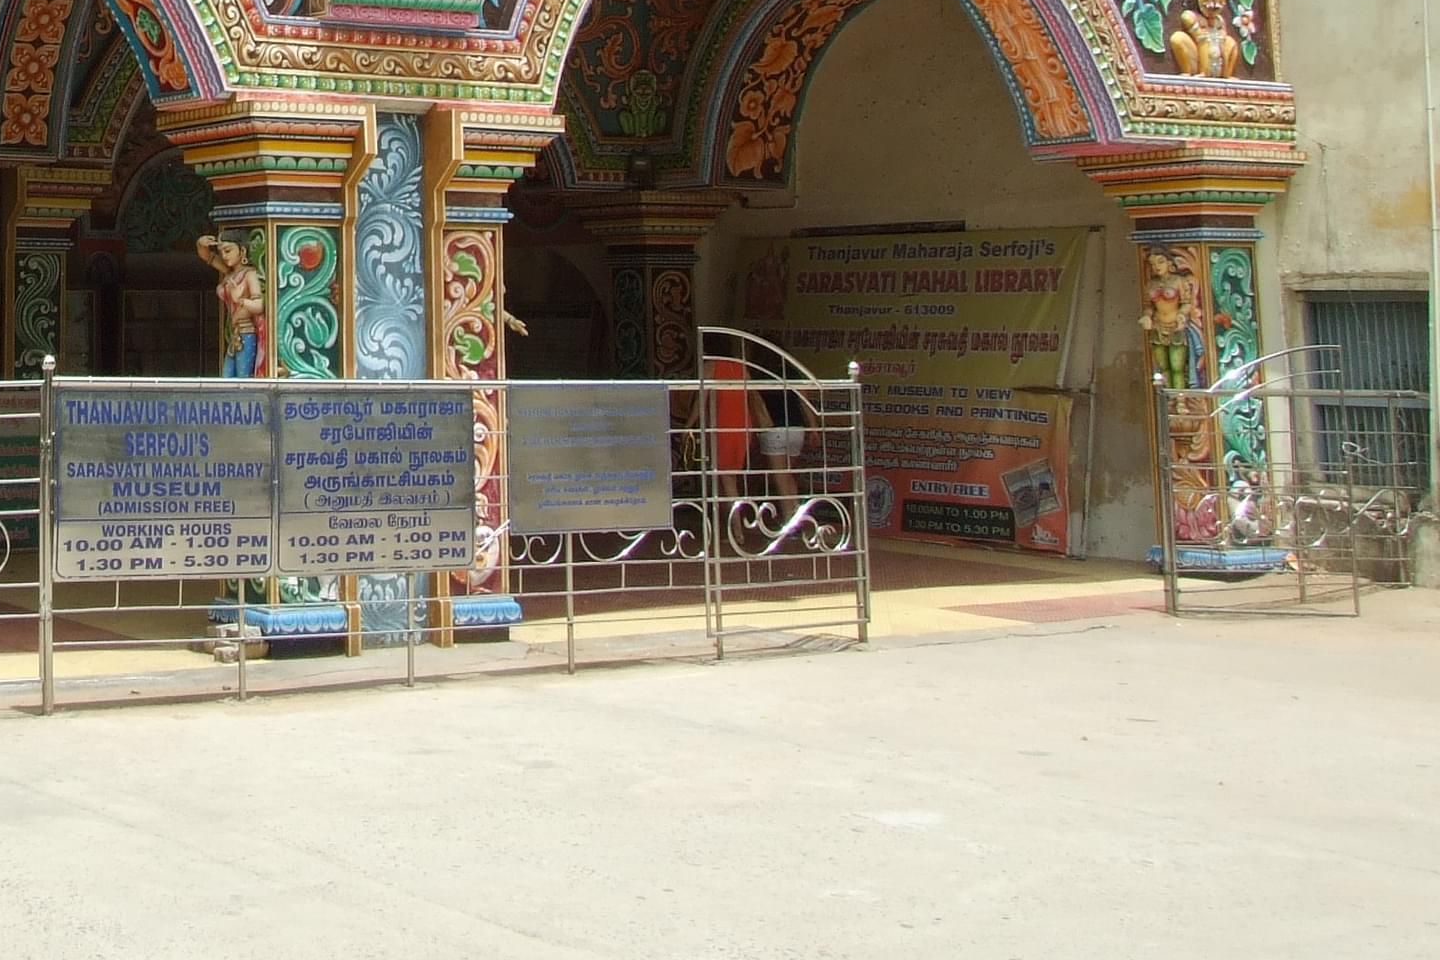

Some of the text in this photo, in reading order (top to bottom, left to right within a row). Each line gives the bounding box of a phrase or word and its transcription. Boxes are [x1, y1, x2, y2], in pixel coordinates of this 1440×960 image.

[808, 240, 1055, 264] Thanjavur Maharaja Serfoji's
[796, 268, 1062, 294] SARASVATI MAHAL LIBRARY
[828, 304, 893, 317] Thanjavur
[904, 304, 955, 315] 613009
[887, 385, 944, 398] MUSEUM
[951, 387, 968, 399] TO
[976, 389, 1011, 400] VIEW
[65, 400, 168, 425] THANJAVUR
[174, 401, 264, 425] MAHARAJA
[284, 397, 465, 421] தஞ்சாவூர் மகாராஜா
[936, 405, 964, 417] AND
[970, 406, 1049, 424] PAINTINGS
[319, 422, 433, 444] சரபோஜியின்
[124, 432, 210, 457] SERFOJI'S
[284, 446, 467, 471] சரசுவதி மகால் நூலகம்
[67, 462, 263, 479] SARASVATI MAHAL LIBRARY
[112, 481, 222, 497] MUSEUM
[303, 470, 455, 492] அருங்காட்சியகம்
[912, 480, 988, 497] ENTRY FREE
[98, 500, 236, 515] (ADMISSION FREE)
[315, 492, 374, 510] அனுமதி
[329, 512, 431, 530] வேலை நேரம்
[945, 506, 960, 517] TO
[990, 510, 1010, 521] PM
[102, 523, 232, 537] WORKING HOURS
[927, 520, 944, 531] PM
[945, 522, 961, 533] TO
[964, 525, 989, 535] 5.30
[992, 526, 1010, 537] PM
[64, 539, 123, 552] 10.00
[130, 537, 163, 550] AM
[186, 536, 229, 548] 1.00
[237, 535, 268, 547] PM
[288, 535, 339, 547] 10.00
[346, 534, 375, 546] AM
[394, 532, 432, 544] 1.00
[439, 531, 466, 542] PM
[76, 558, 122, 571] 1.30
[130, 557, 163, 570] PM
[184, 555, 229, 567] 5.30
[236, 554, 268, 566] PM
[300, 552, 339, 564] 1.30
[346, 551, 374, 563] PM
[393, 549, 432, 561] 5.30
[438, 548, 466, 559] PM
